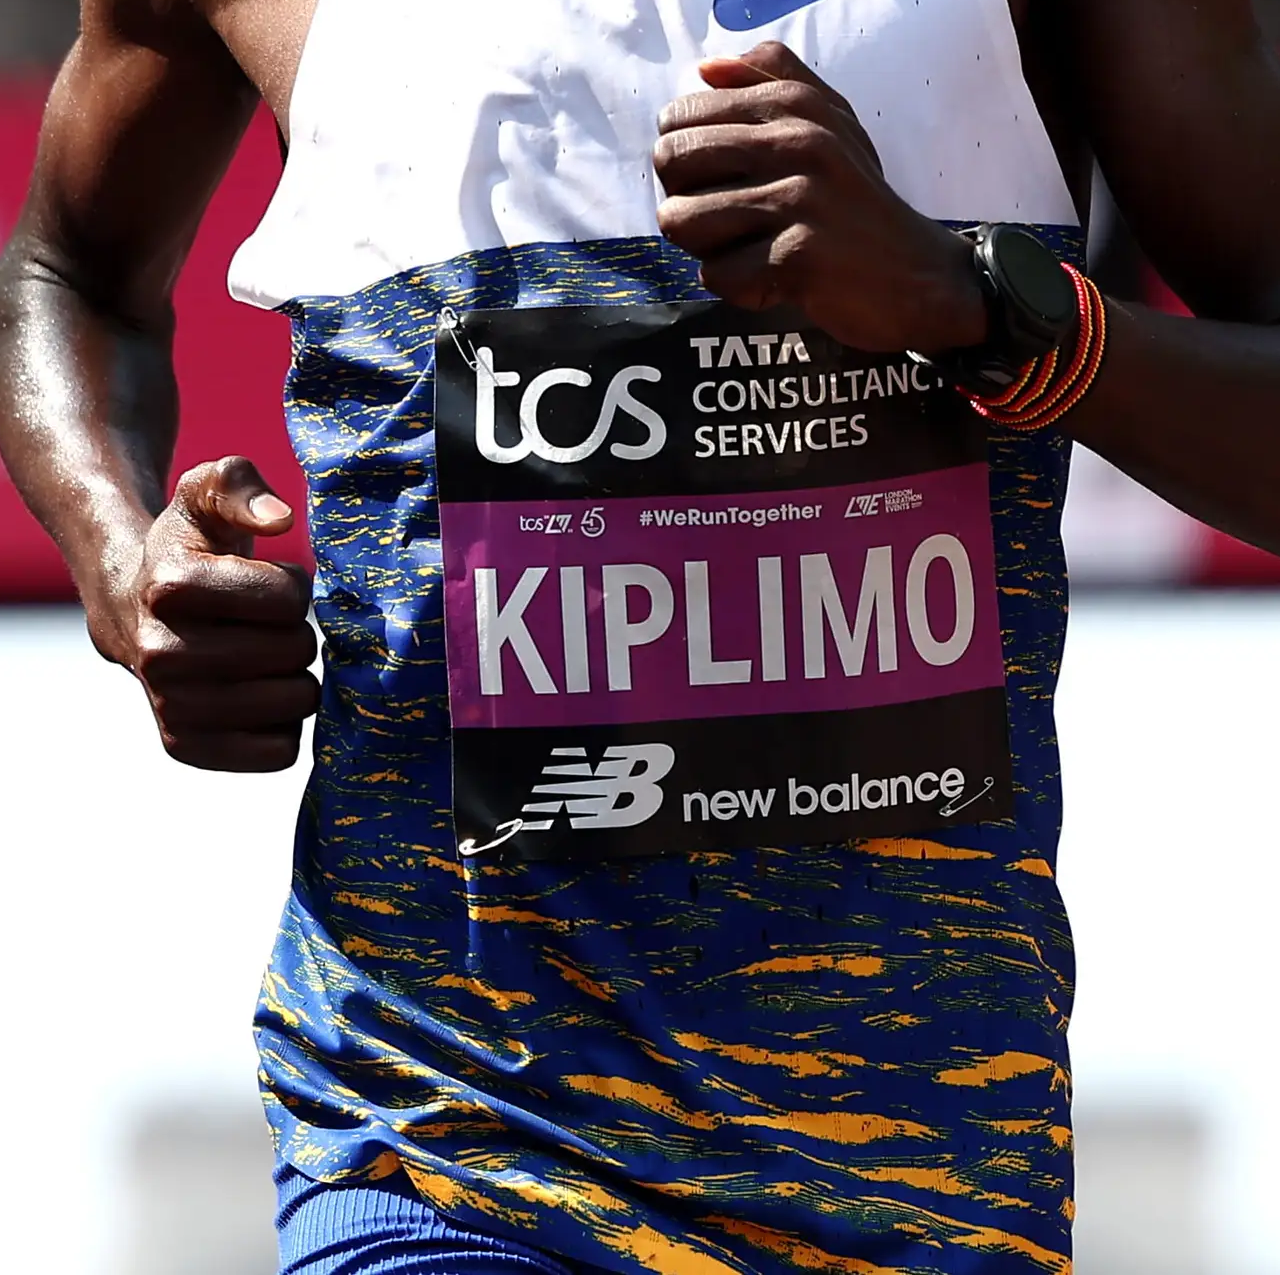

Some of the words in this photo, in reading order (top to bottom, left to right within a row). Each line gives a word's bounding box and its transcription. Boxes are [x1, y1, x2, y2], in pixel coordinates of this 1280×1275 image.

[689, 332, 812, 368] TATA
[474, 345, 667, 464] tcs
[692, 363, 944, 413] CONSULTANC
[694, 413, 869, 458] SERVICES
[639, 502, 823, 527] #WeRunTogether
[474, 533, 976, 696] KIPLIMO
[682, 786, 777, 822] new
[788, 766, 967, 817] balance
